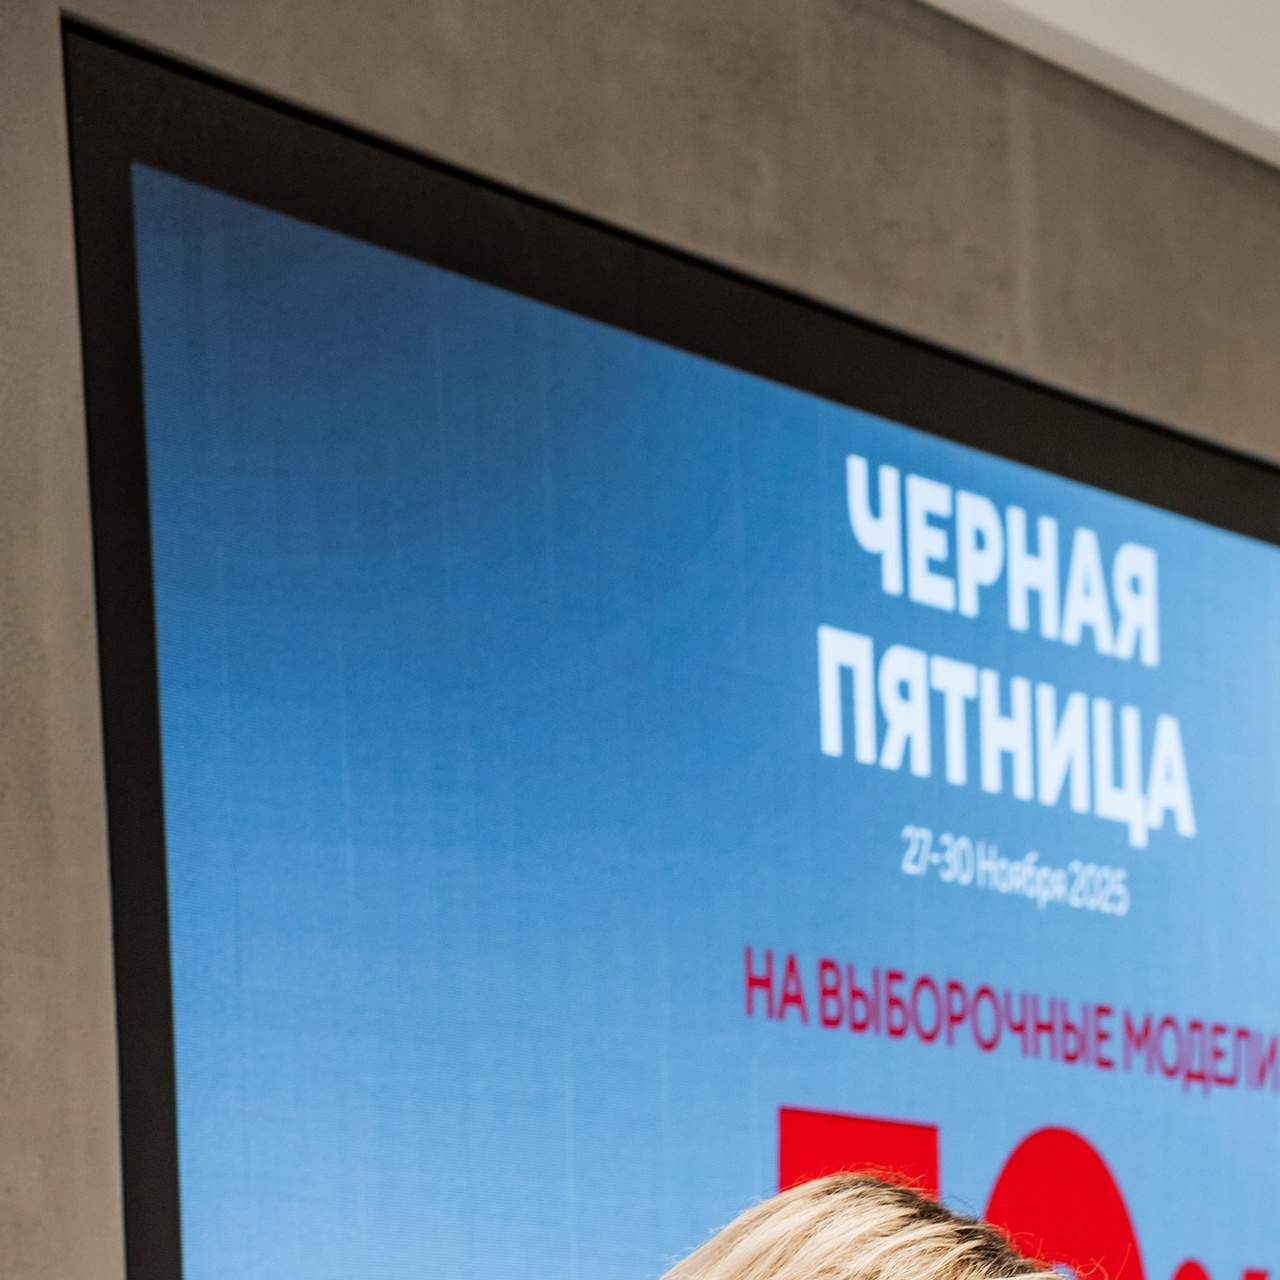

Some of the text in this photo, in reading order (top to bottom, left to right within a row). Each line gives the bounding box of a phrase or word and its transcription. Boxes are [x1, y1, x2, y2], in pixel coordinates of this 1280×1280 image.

[846, 454, 1160, 668] ЧЕРНАЯ
[817, 625, 1197, 849] ПЯТНИЦА
[901, 824, 975, 886] 27-30
[1067, 859, 1131, 917] 2025
[744, 945, 1280, 1096] НА ВЫБОРОЧНЫЕ МОДЕЛИ
